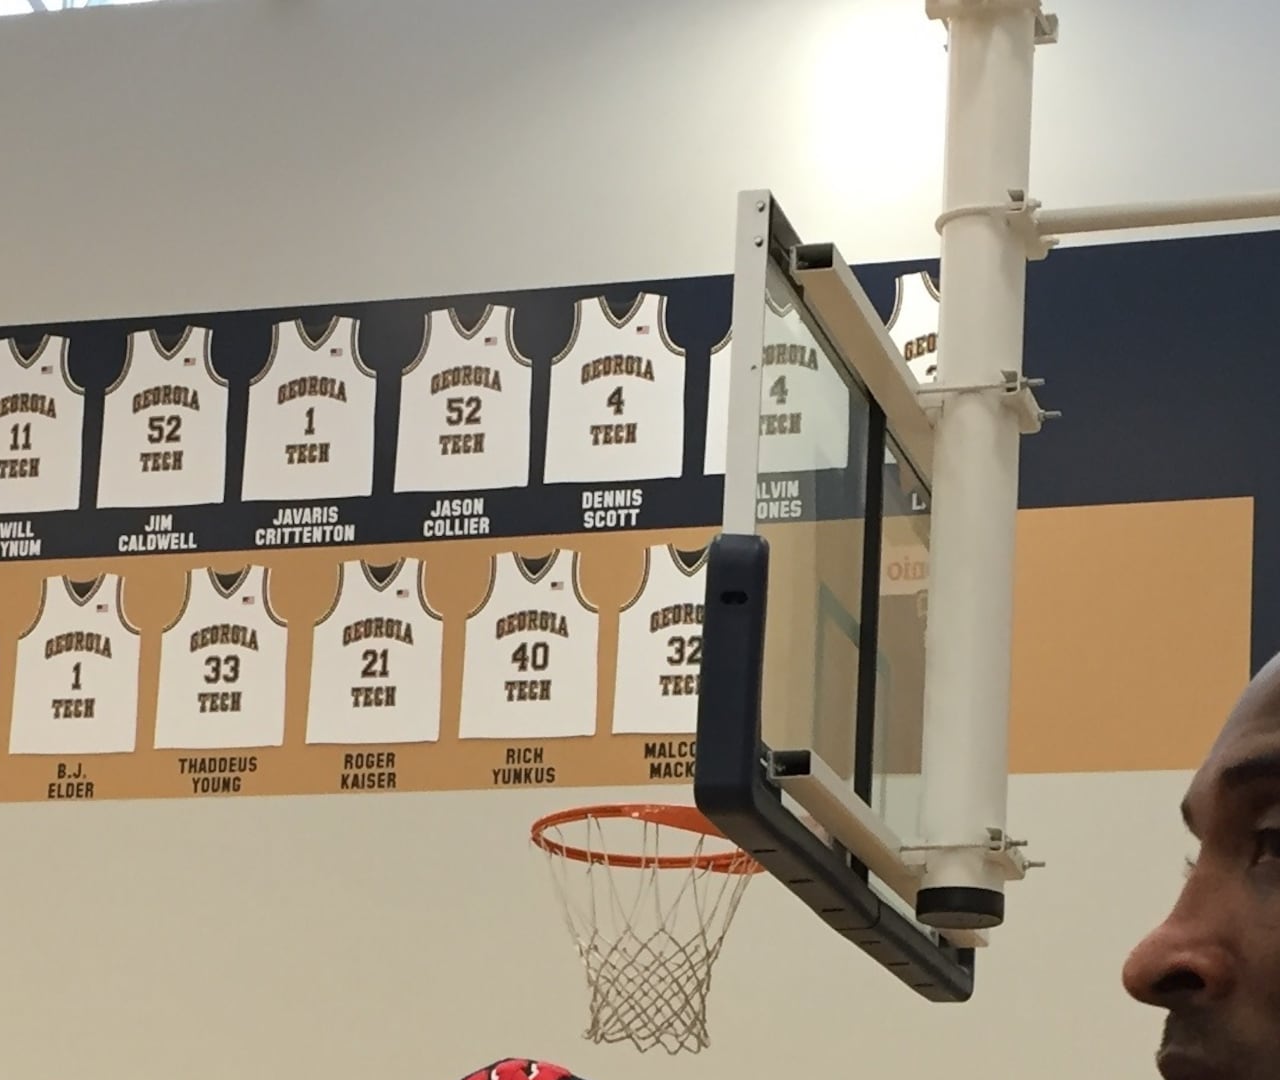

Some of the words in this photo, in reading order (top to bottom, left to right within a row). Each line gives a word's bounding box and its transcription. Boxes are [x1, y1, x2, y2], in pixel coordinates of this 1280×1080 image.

[761, 344, 819, 370] ORGIA
[431, 365, 502, 395] GEORGIA
[581, 355, 655, 384] GEORGIA
[132, 385, 200, 413] GEORGIA
[277, 376, 347, 405] GEORGIA
[607, 386, 624, 415] 4
[770, 375, 788, 404] 4
[304, 408, 315, 435] 1
[446, 397, 482, 426] 52
[10, 423, 32, 450] 11
[148, 415, 181, 443] 52
[590, 422, 638, 445] TECH
[286, 443, 330, 464] TECH
[439, 433, 485, 455] TECH
[140, 451, 183, 472] TECH
[430, 498, 484, 517] JASON
[582, 489, 643, 509] DENNIS
[757, 500, 802, 519] ONES
[145, 514, 173, 531] JIM
[273, 506, 339, 526] JAVARIS
[423, 516, 490, 537] COLLIER
[584, 509, 640, 528] SCOTT
[0, 521, 34, 539] WILL
[255, 525, 355, 546] CRITTENTON
[118, 532, 197, 551] CALDWELL
[495, 610, 569, 639] GEORGIA
[650, 603, 704, 633] GEORG
[189, 624, 259, 652] GEORGIA
[342, 616, 414, 646] GEORGIA
[44, 631, 112, 659] GEORGIA
[361, 649, 389, 678] 21
[511, 642, 550, 671] 40
[71, 662, 82, 690] 1
[203, 655, 240, 684] 33
[351, 685, 397, 708] TECH
[504, 679, 551, 702] TECH
[659, 675, 701, 696] TEC
[51, 698, 95, 719] TECH
[198, 691, 242, 713] TECH
[179, 756, 258, 774] THADDEUS
[344, 752, 396, 770] ROGER
[505, 747, 544, 764] RICH
[57, 763, 87, 779] B.J.
[340, 773, 397, 789] KAISER
[492, 767, 556, 785] YUNKUS
[649, 761, 696, 779] MACK
[48, 782, 94, 799] ELDER
[191, 776, 241, 793] YOUNG
